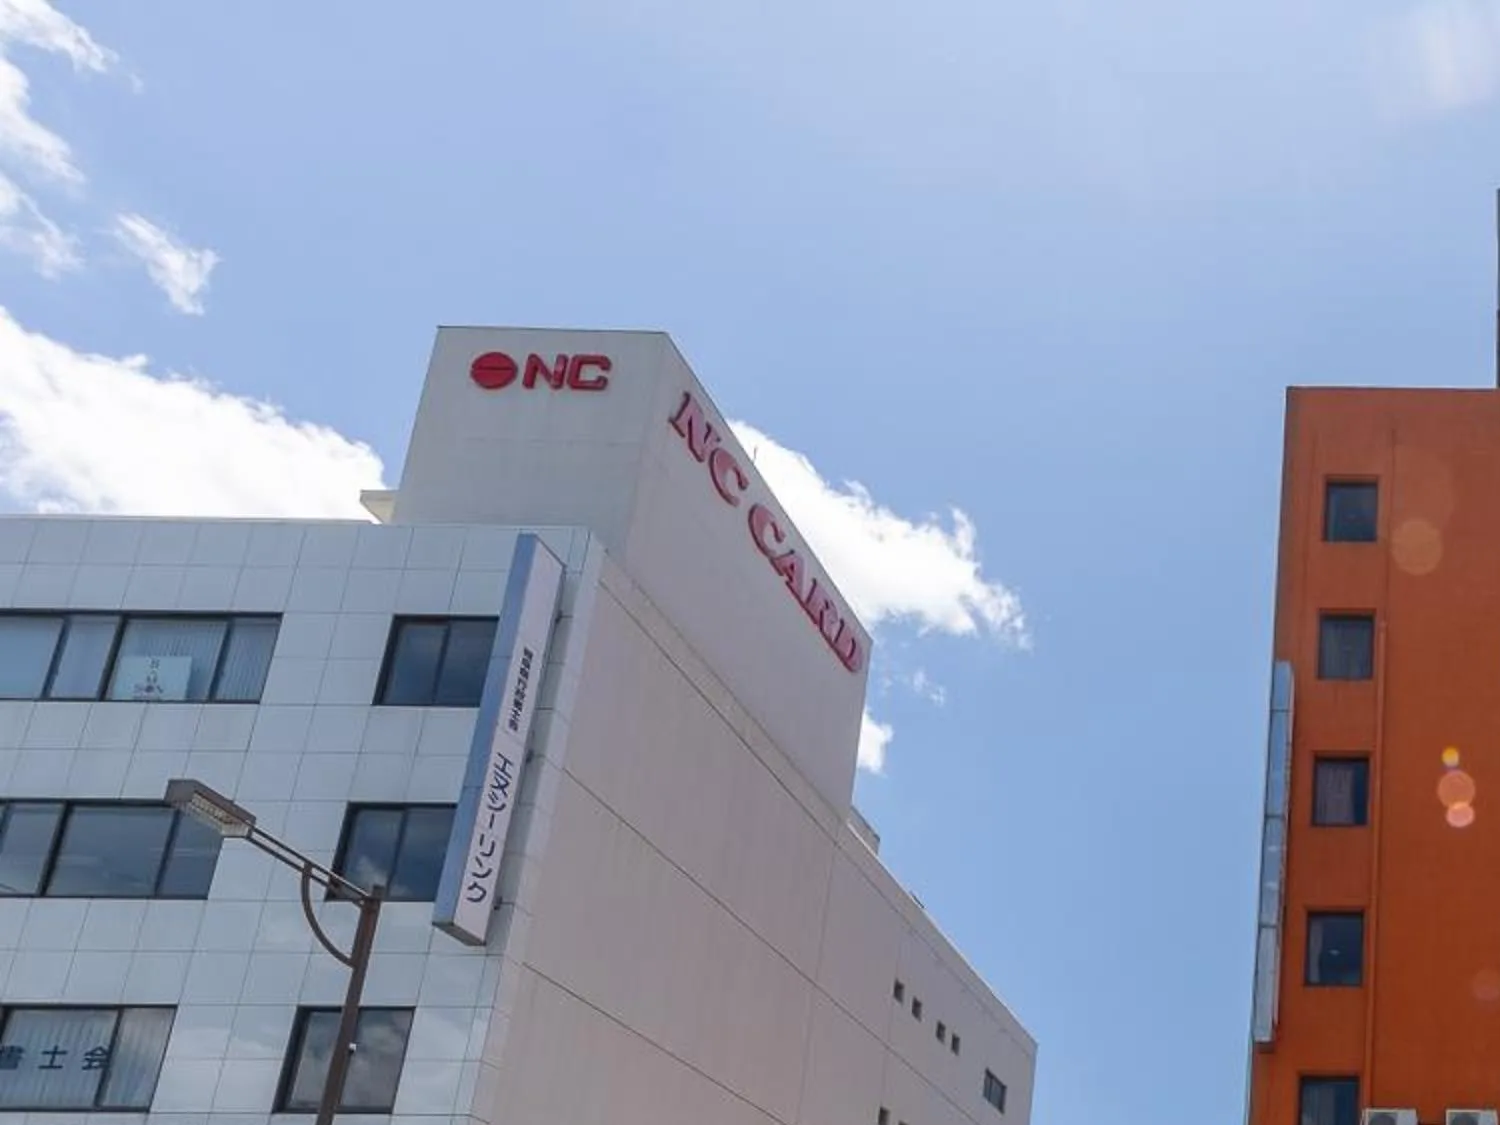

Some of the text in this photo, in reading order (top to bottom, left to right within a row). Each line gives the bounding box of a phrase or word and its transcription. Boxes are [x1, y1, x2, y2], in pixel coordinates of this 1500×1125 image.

[521, 353, 612, 391] NC
[668, 391, 863, 674] NC CARD
[466, 753, 514, 903] エヌシーリンク
